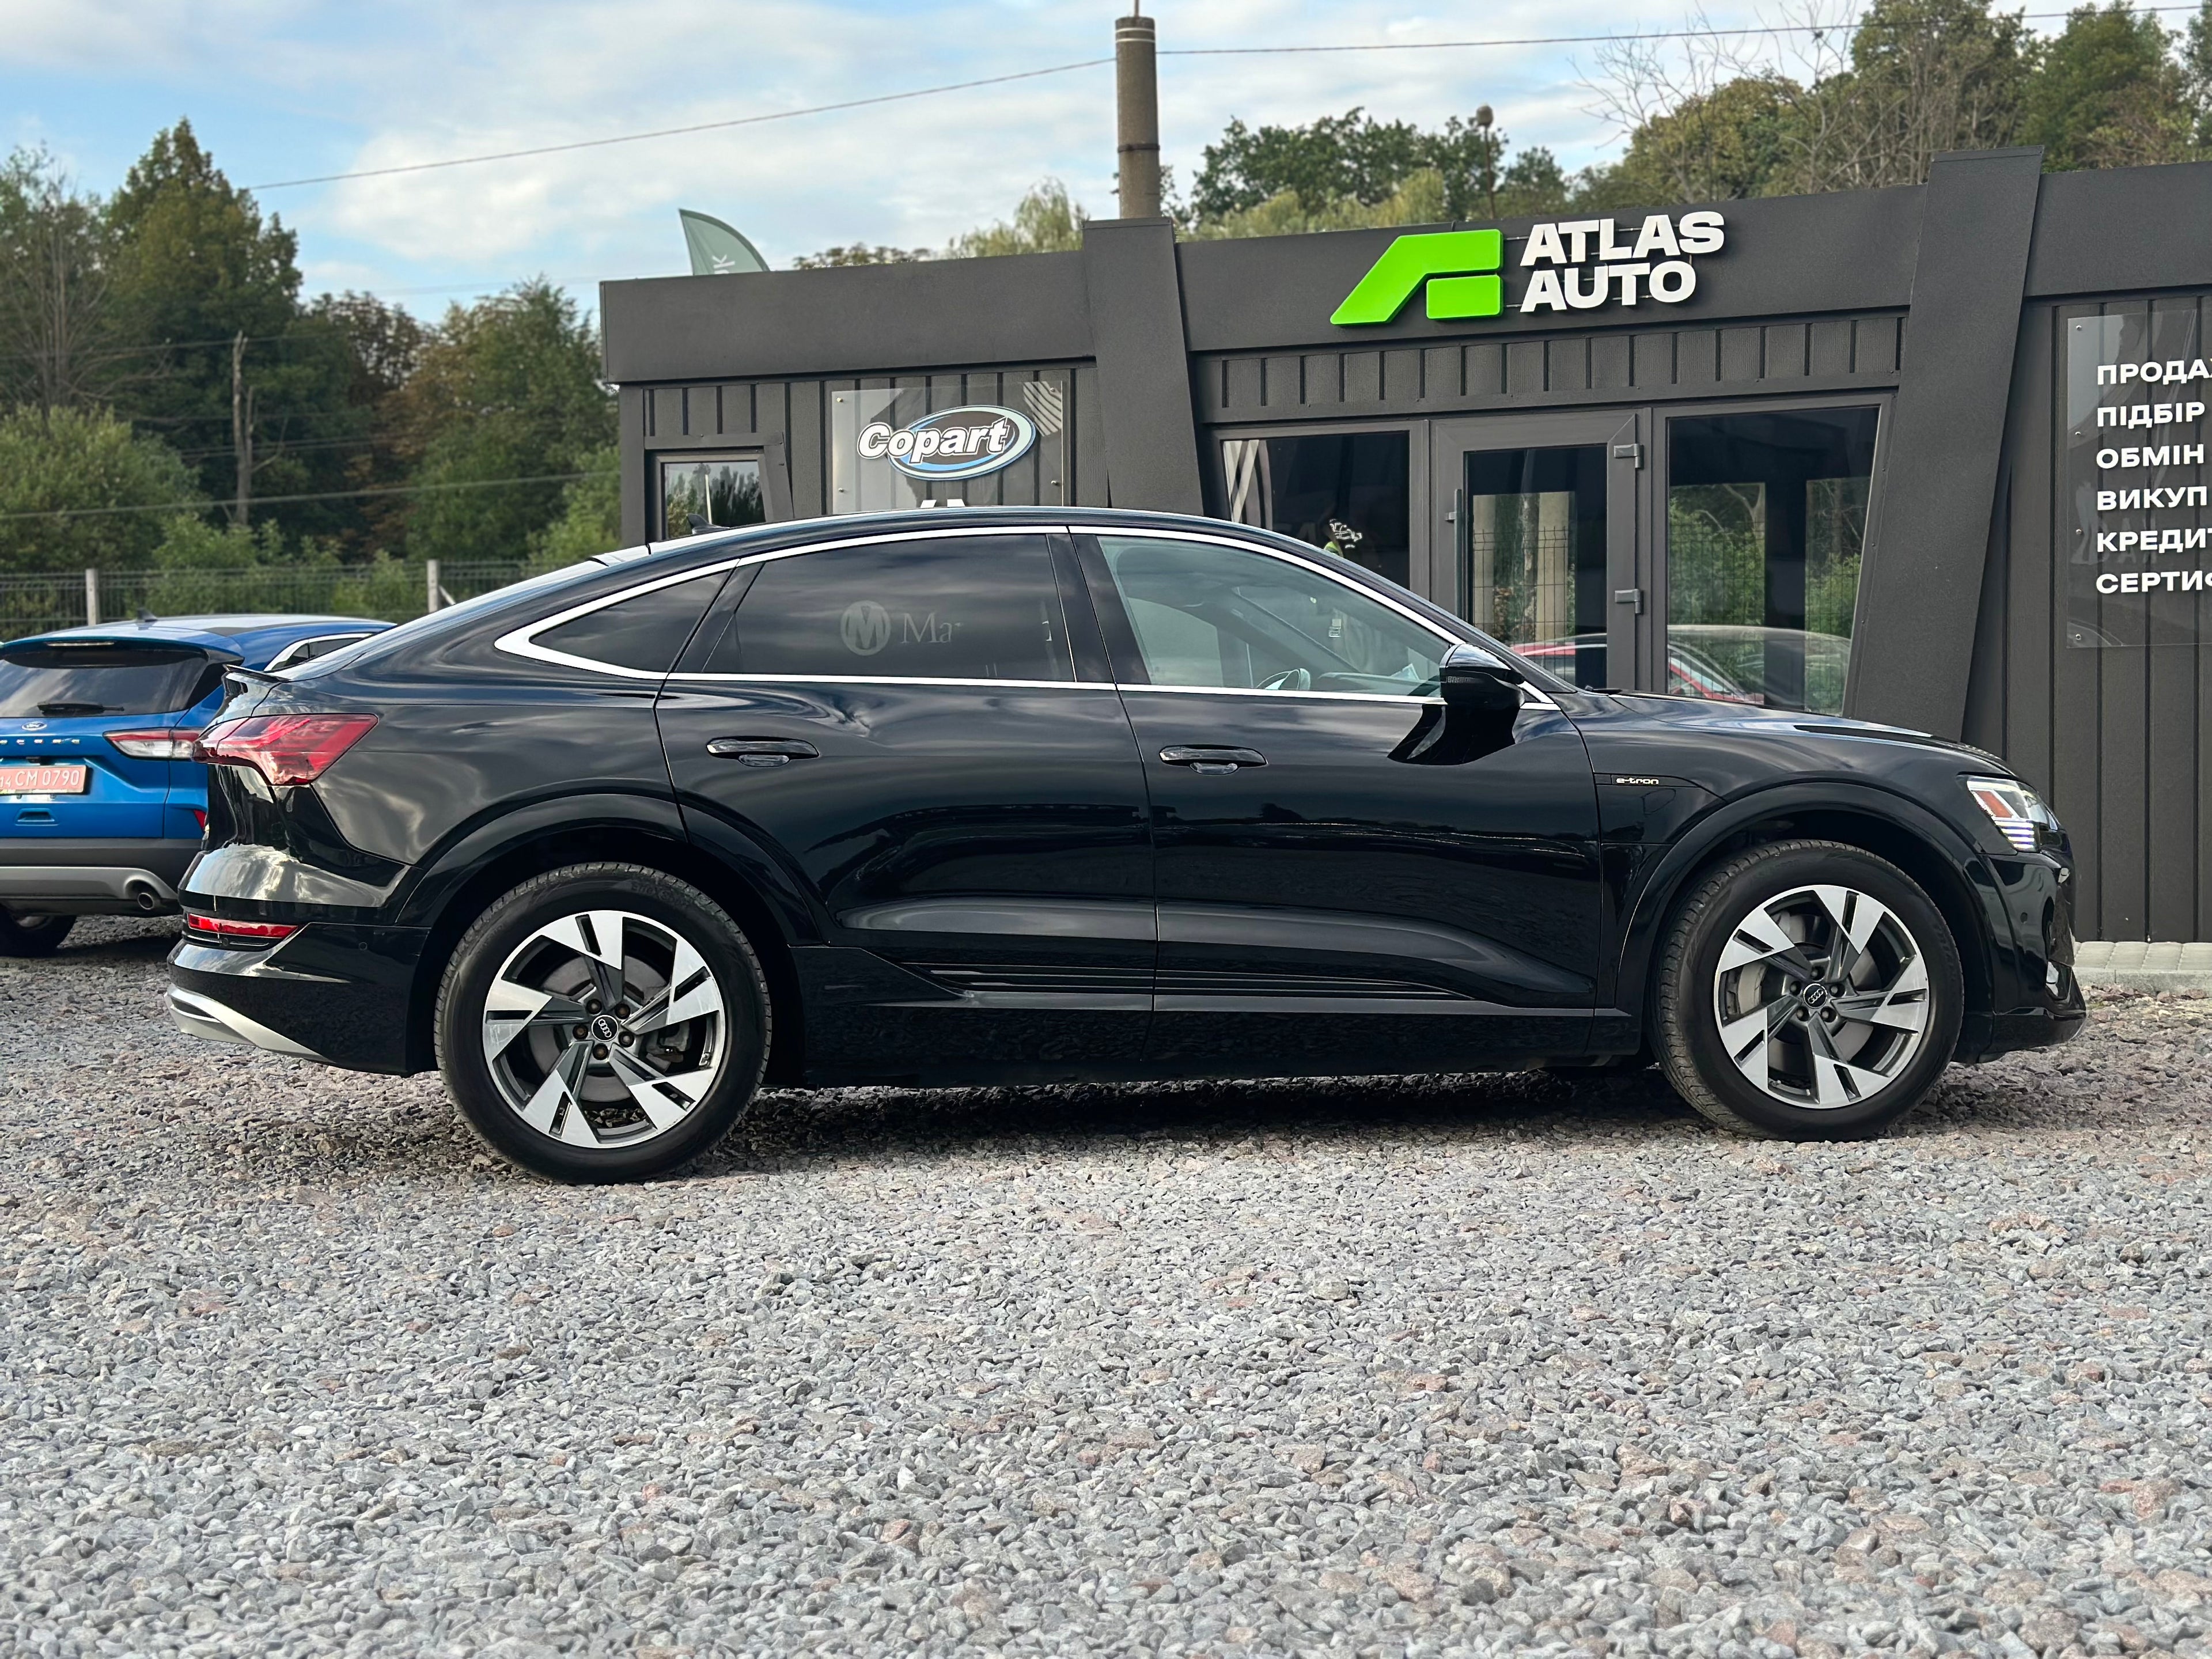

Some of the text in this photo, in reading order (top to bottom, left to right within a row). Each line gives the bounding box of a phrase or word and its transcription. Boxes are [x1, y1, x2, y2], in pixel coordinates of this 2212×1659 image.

[1520, 211, 1724, 266] ATLAS
[1520, 260, 1696, 312] AUTO
[2097, 359, 2212, 385] ПРОДА
[2097, 402, 2205, 429] ПІДБІР
[857, 415, 1010, 464] Copart
[2096, 444, 2204, 469] ОБМІН
[2097, 486, 2207, 510] ВИКУП
[2097, 528, 2212, 554] КРЕДИ
[42, 770, 80, 786] 0790
